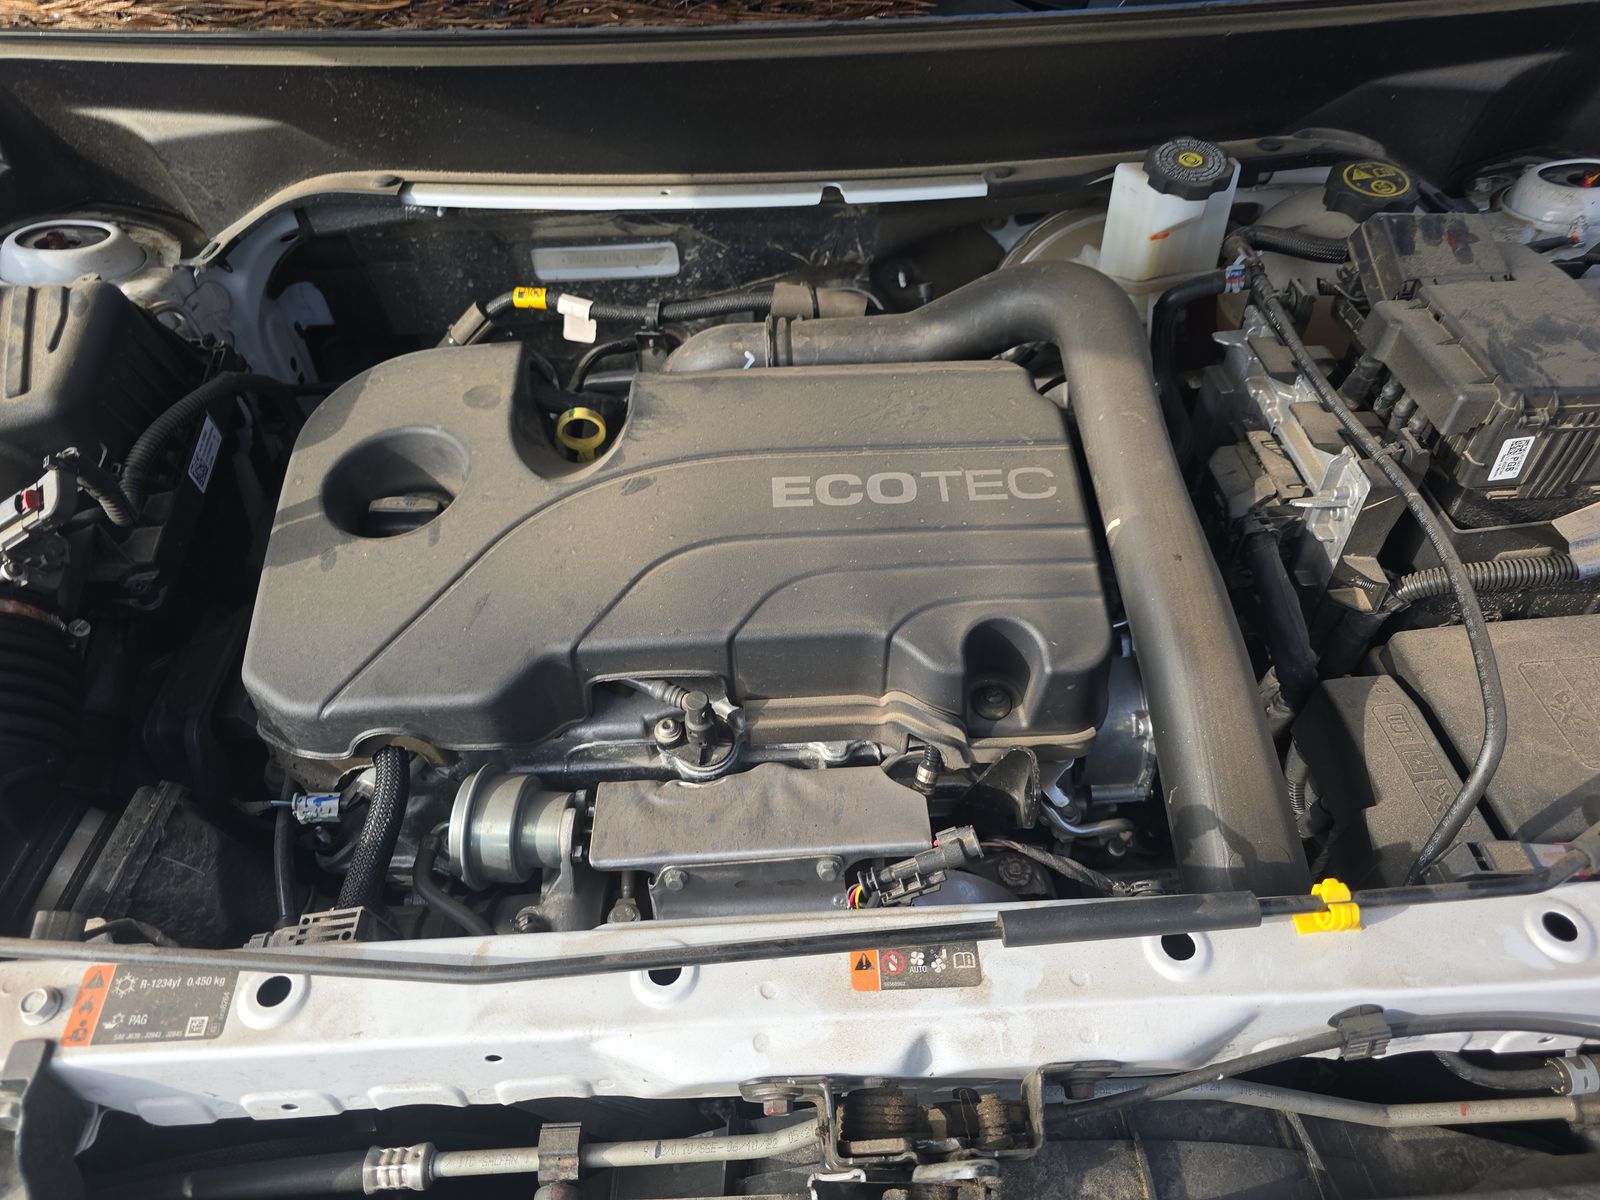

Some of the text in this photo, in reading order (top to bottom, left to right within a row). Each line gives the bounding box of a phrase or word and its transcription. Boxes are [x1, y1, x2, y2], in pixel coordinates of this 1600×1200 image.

[771, 467, 1057, 508] ECOTEC
[909, 965, 928, 973] AUTO
[139, 975, 226, 989] R-1234yf 0.450 kg
[128, 1013, 149, 1026] PAG
